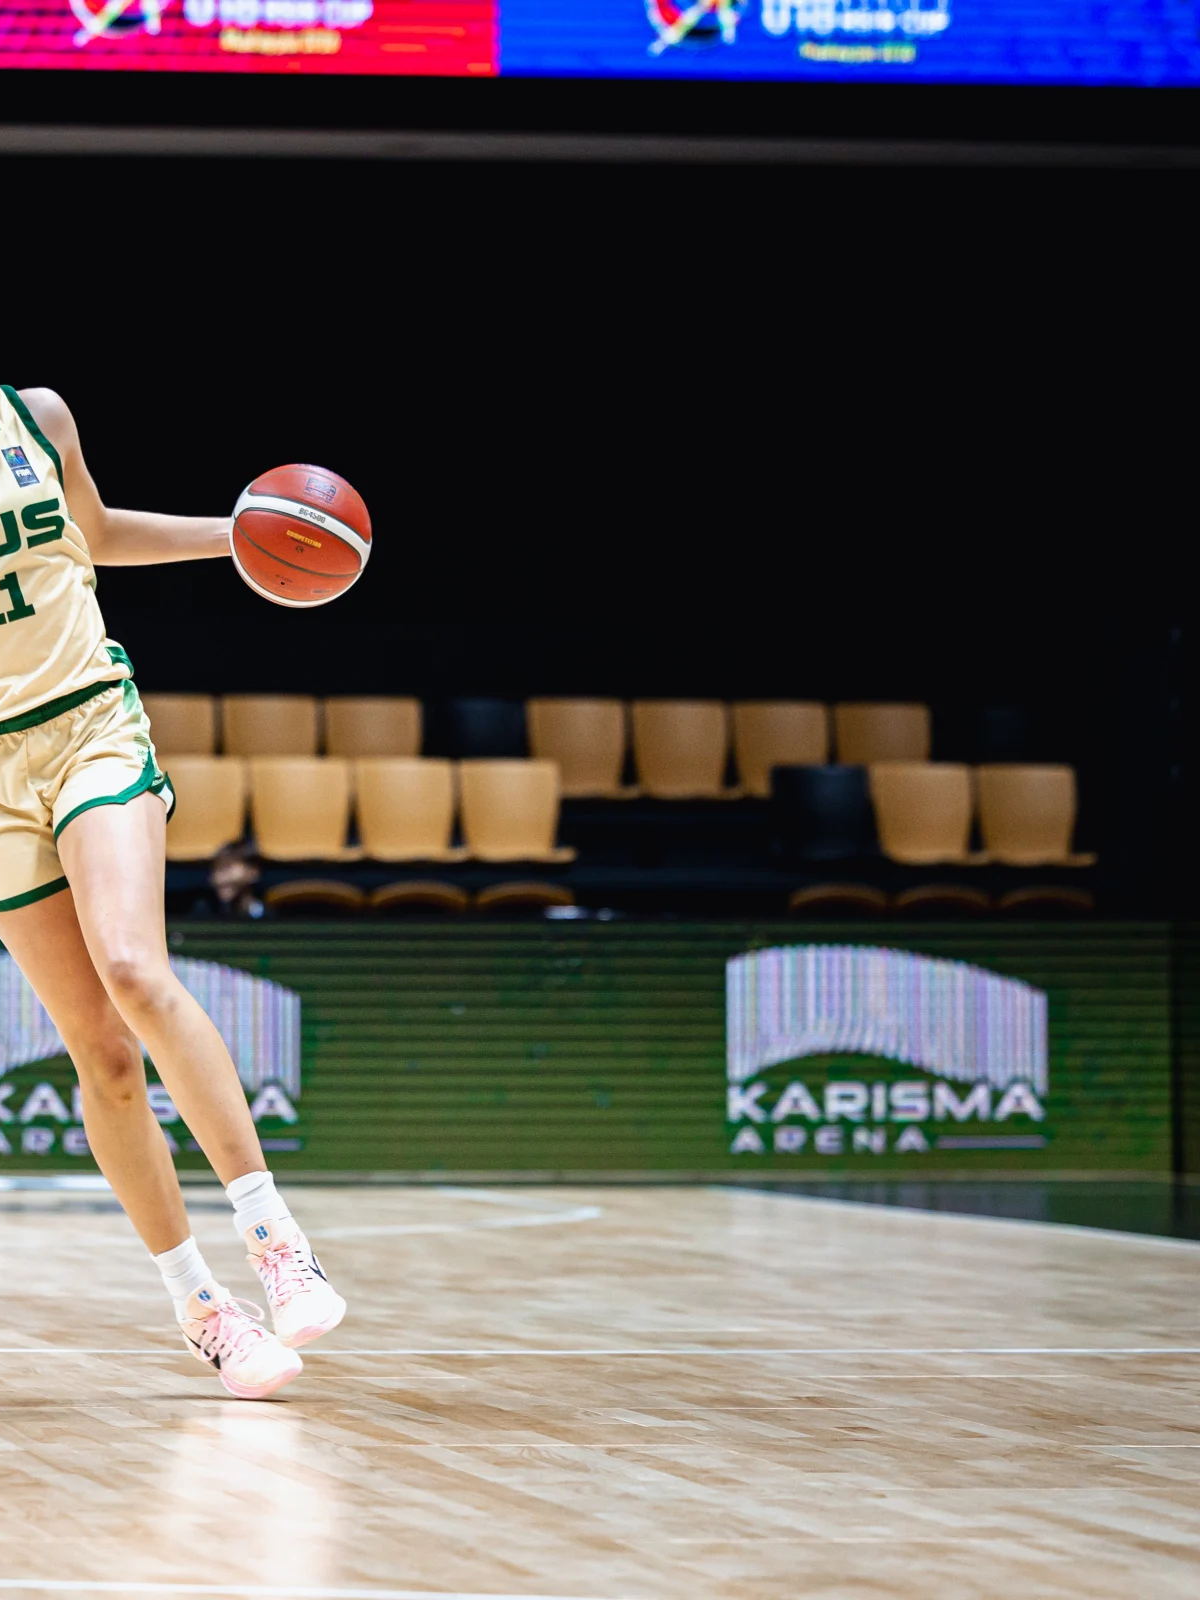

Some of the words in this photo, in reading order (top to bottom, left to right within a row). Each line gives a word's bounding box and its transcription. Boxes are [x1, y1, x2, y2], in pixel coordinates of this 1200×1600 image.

[299, 508, 326, 523] BG4500
[726, 1081, 1046, 1122] KARISMA
[730, 1126, 931, 1154] ARENA
